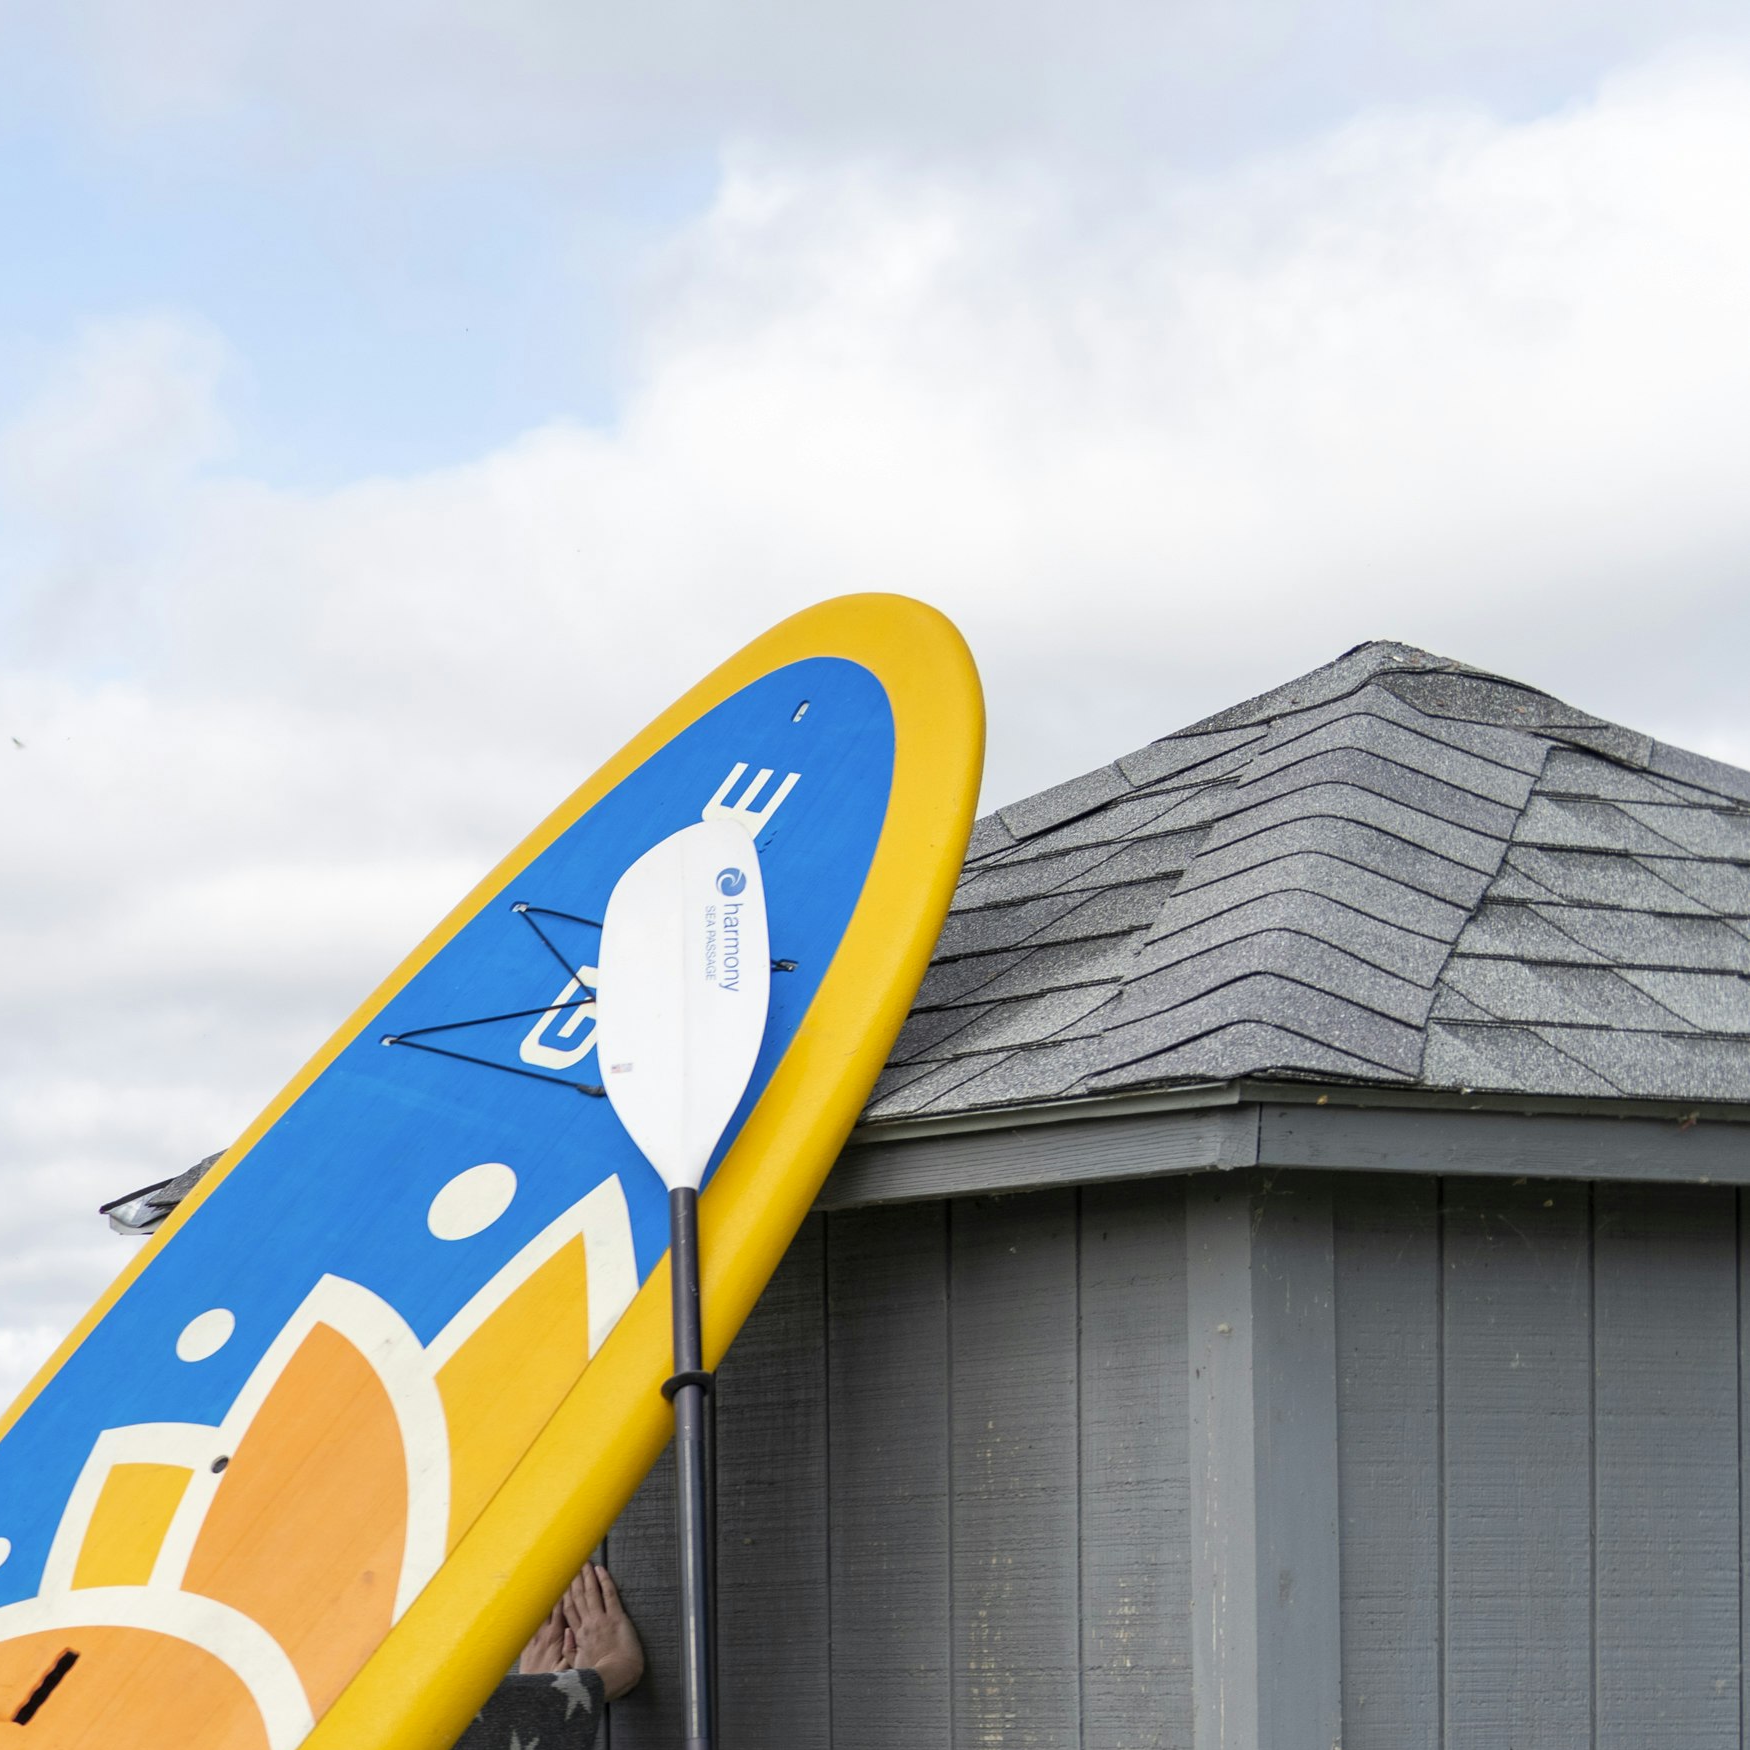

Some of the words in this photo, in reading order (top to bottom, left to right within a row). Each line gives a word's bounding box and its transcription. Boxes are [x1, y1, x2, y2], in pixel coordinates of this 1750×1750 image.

[705, 905, 717, 928] SEA
[705, 930, 717, 981] PASSAGE
[718, 902, 744, 993] harmony
